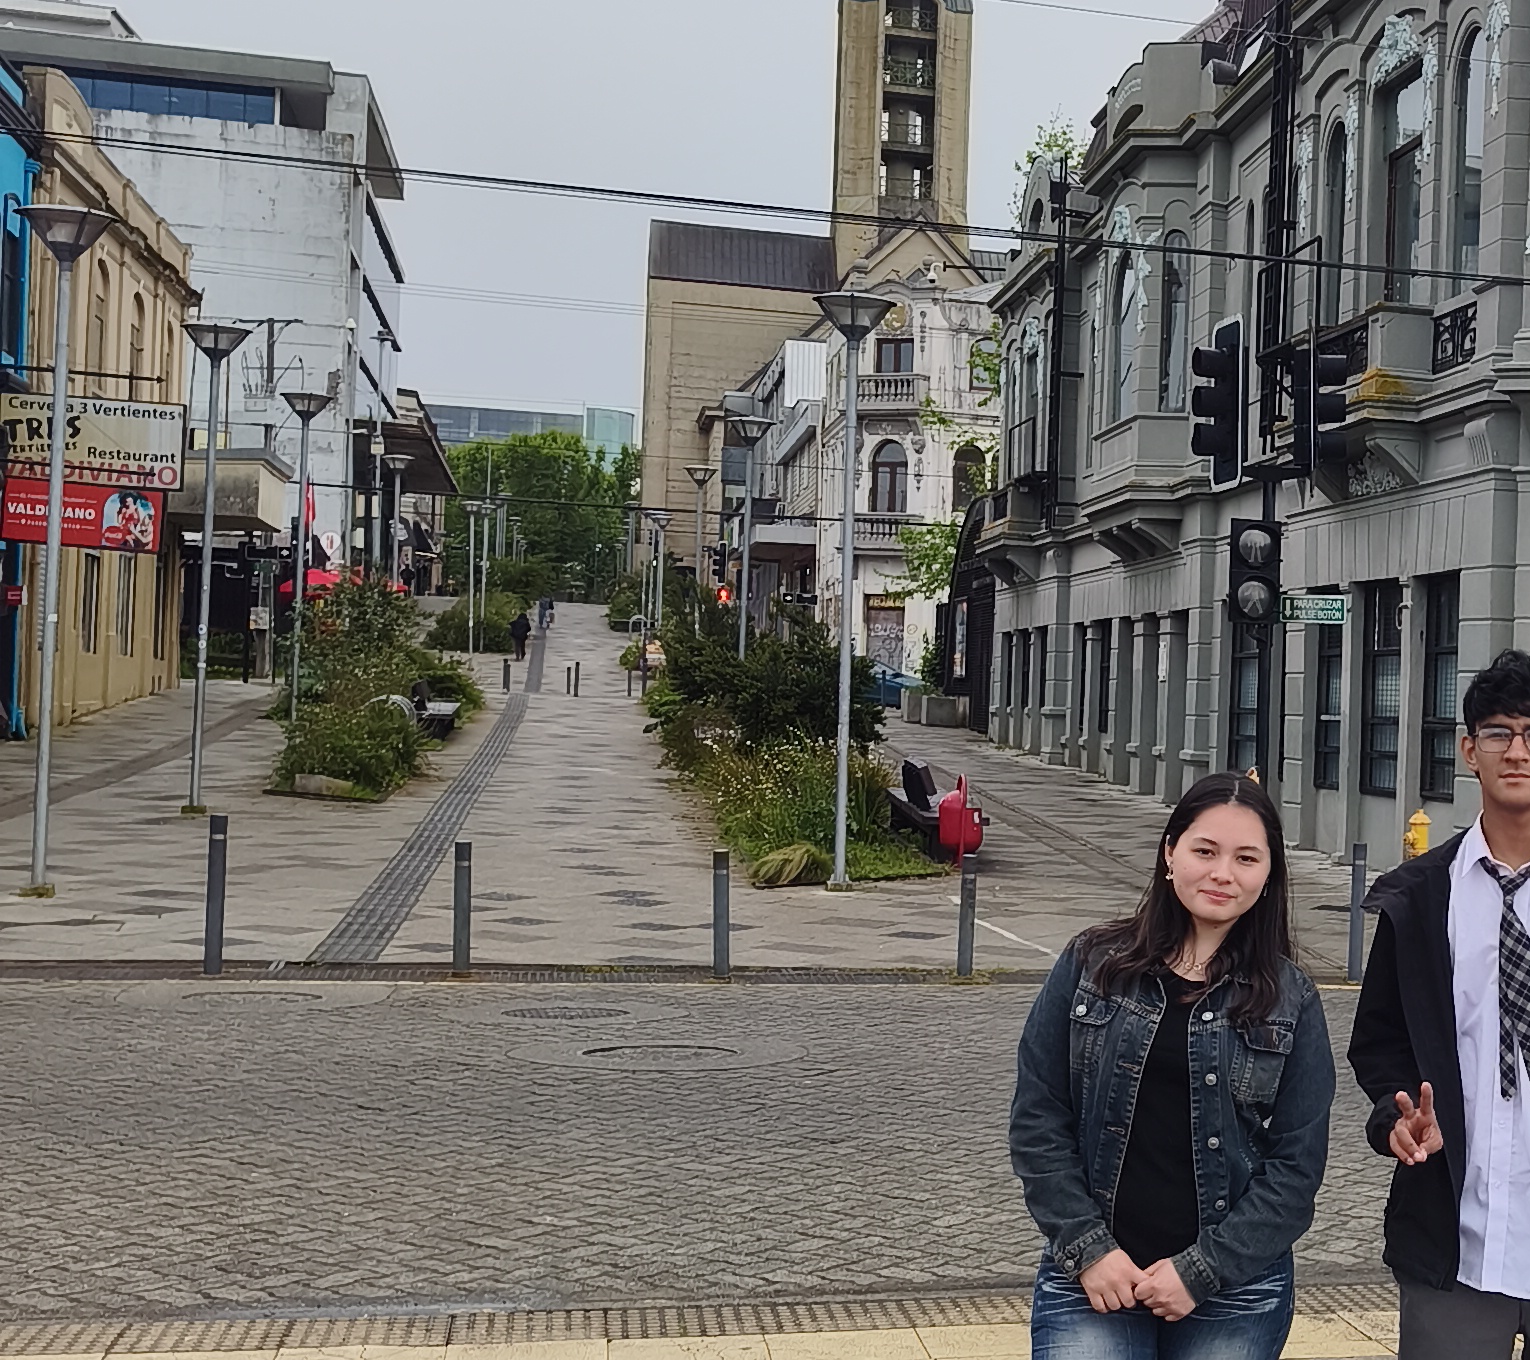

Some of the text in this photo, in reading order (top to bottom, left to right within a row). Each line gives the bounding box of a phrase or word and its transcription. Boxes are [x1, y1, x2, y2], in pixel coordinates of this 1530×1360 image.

[9, 396, 176, 421] Cervea 3 Vertientes
[87, 446, 176, 464] Restaurant
[1294, 599, 1341, 609] PARA CRUZAR
[1294, 610, 1317, 619] PULSE
